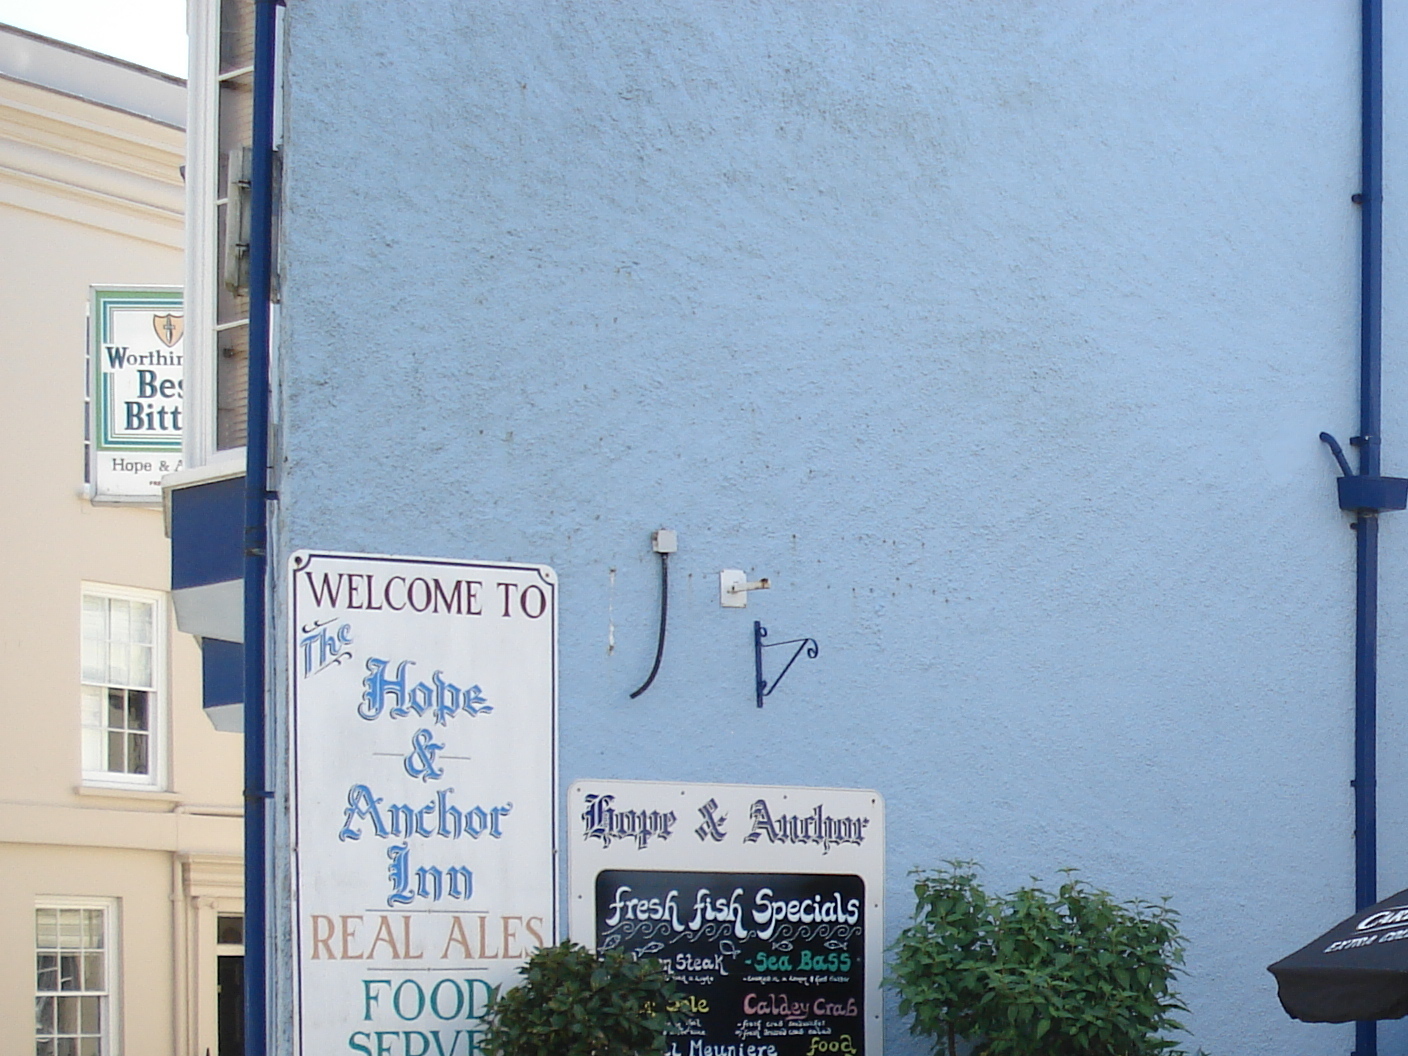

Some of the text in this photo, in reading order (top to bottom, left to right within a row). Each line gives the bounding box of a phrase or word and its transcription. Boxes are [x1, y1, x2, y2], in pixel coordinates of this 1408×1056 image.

[112, 458, 152, 474] Hope
[159, 460, 170, 472] &
[305, 572, 547, 619] WELCOME TO
[300, 623, 353, 679] The
[358, 656, 494, 727] Hope
[403, 728, 445, 782] &
[339, 784, 513, 842] Anchor
[581, 793, 870, 855] Hope & Anchor
[387, 841, 473, 907] Inn
[752, 888, 860, 940] Specials
[310, 915, 544, 961] REAL ALES
[754, 950, 851, 972] Sea Bass
[676, 953, 729, 976] Steak
[362, 978, 492, 1021] FOOD
[666, 995, 710, 1013] Sle
[743, 993, 858, 1021] Caldey Crab
[806, 1034, 857, 1056] food
